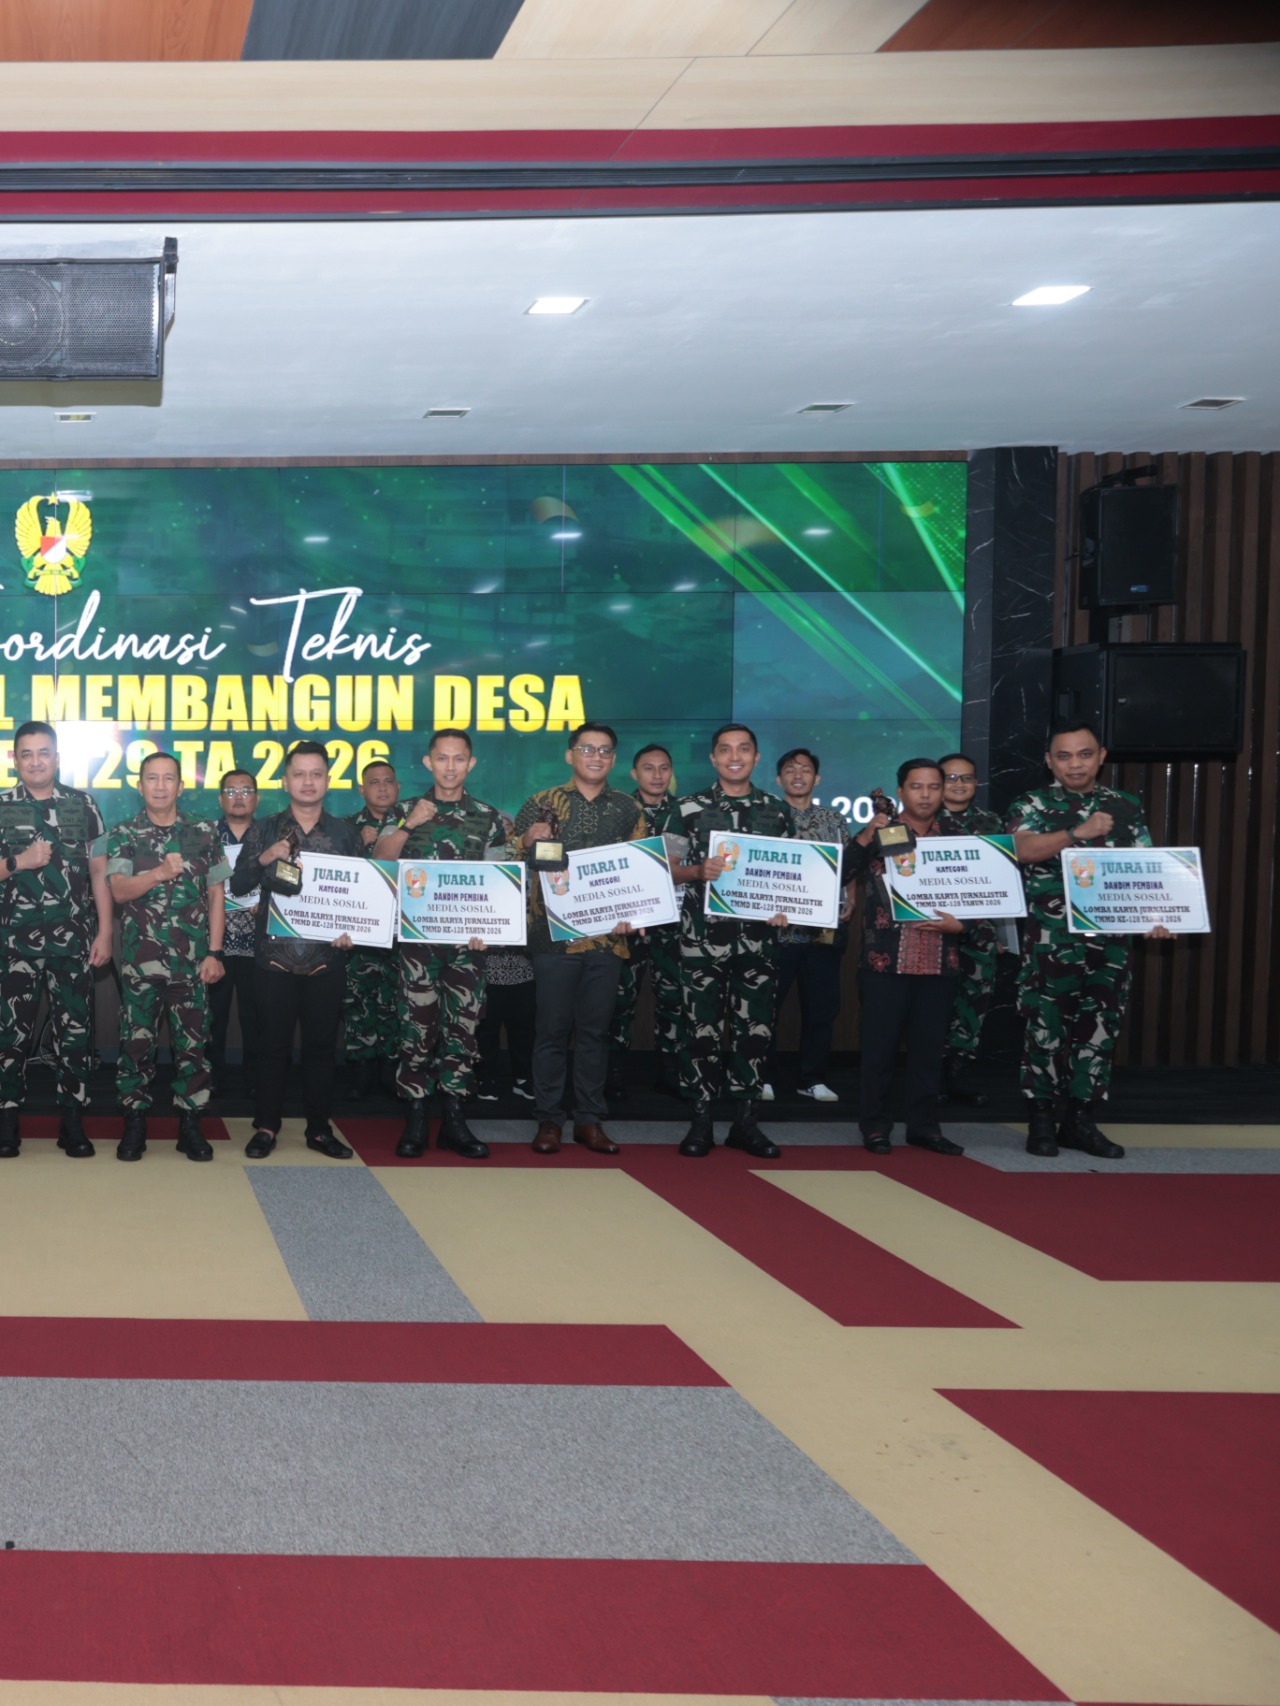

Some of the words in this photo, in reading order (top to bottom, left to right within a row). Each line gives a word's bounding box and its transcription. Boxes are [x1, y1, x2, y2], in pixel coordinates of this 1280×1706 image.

[249, 587, 432, 683] Teknis
[31, 674, 414, 732] MEMBANGUN
[433, 674, 586, 732] DESA
[173, 740, 238, 789] TA
[252, 740, 392, 790] 226
[747, 849, 789, 864] JUARA
[791, 854, 802, 864] II
[922, 850, 963, 865] JUARA
[965, 850, 980, 860] III
[577, 861, 617, 880] JUARA
[619, 857, 629, 870] II
[745, 868, 771, 878] DANDIM
[773, 870, 802, 881] PEMBINA
[936, 866, 968, 874] KATEGORI
[1101, 862, 1144, 876] JUARA
[1146, 862, 1162, 874] III
[312, 868, 353, 883] JUARA
[354, 872, 359, 883] I
[438, 874, 475, 888] JUARA
[478, 875, 484, 886] I
[589, 875, 620, 887] KATEGORI
[919, 877, 952, 887] MEDIA
[954, 876, 992, 885] SOSIAL
[319, 885, 349, 894] KATEGORI
[737, 878, 770, 890] MEDIA
[772, 882, 809, 893] SOSIAL
[1104, 881, 1130, 890] DANDIM
[1132, 881, 1163, 890] PEMBINA
[434, 892, 459, 901] DANDIM
[460, 893, 488, 902] PEMBINA
[573, 892, 606, 903] MEDIA
[607, 885, 644, 899] SOSIAL
[721, 890, 747, 899] LOMBA
[749, 892, 773, 901] KARYA
[775, 894, 823, 907] JURNALISTIK
[907, 893, 933, 901] LOMBA
[935, 892, 959, 900] KARYA
[960, 891, 1008, 900] JURNALISTIK
[1098, 893, 1132, 902] MEDIA
[1134, 893, 1173, 901] SOSIAL
[300, 895, 332, 907] MEDIA
[333, 899, 368, 910] SOSIAL
[427, 904, 459, 913] MEDIA
[460, 905, 496, 913] SOSIAL
[562, 910, 589, 920] LOMBA
[590, 905, 614, 916] KARYA
[614, 898, 661, 914] JURNALISTIK
[774, 904, 797, 914] TAHUN
[617, 909, 638, 919] TAHUN
[1139, 906, 1190, 915] JURNALISTIK
[284, 909, 309, 919] LOMBA
[311, 911, 333, 922] KARYA
[335, 914, 380, 926] JURNALISTIK
[464, 918, 510, 926] JURNALISTIK
[334, 923, 355, 931] TAHUN
[422, 925, 442, 933] TMMD
[465, 926, 486, 934] TAHUN
